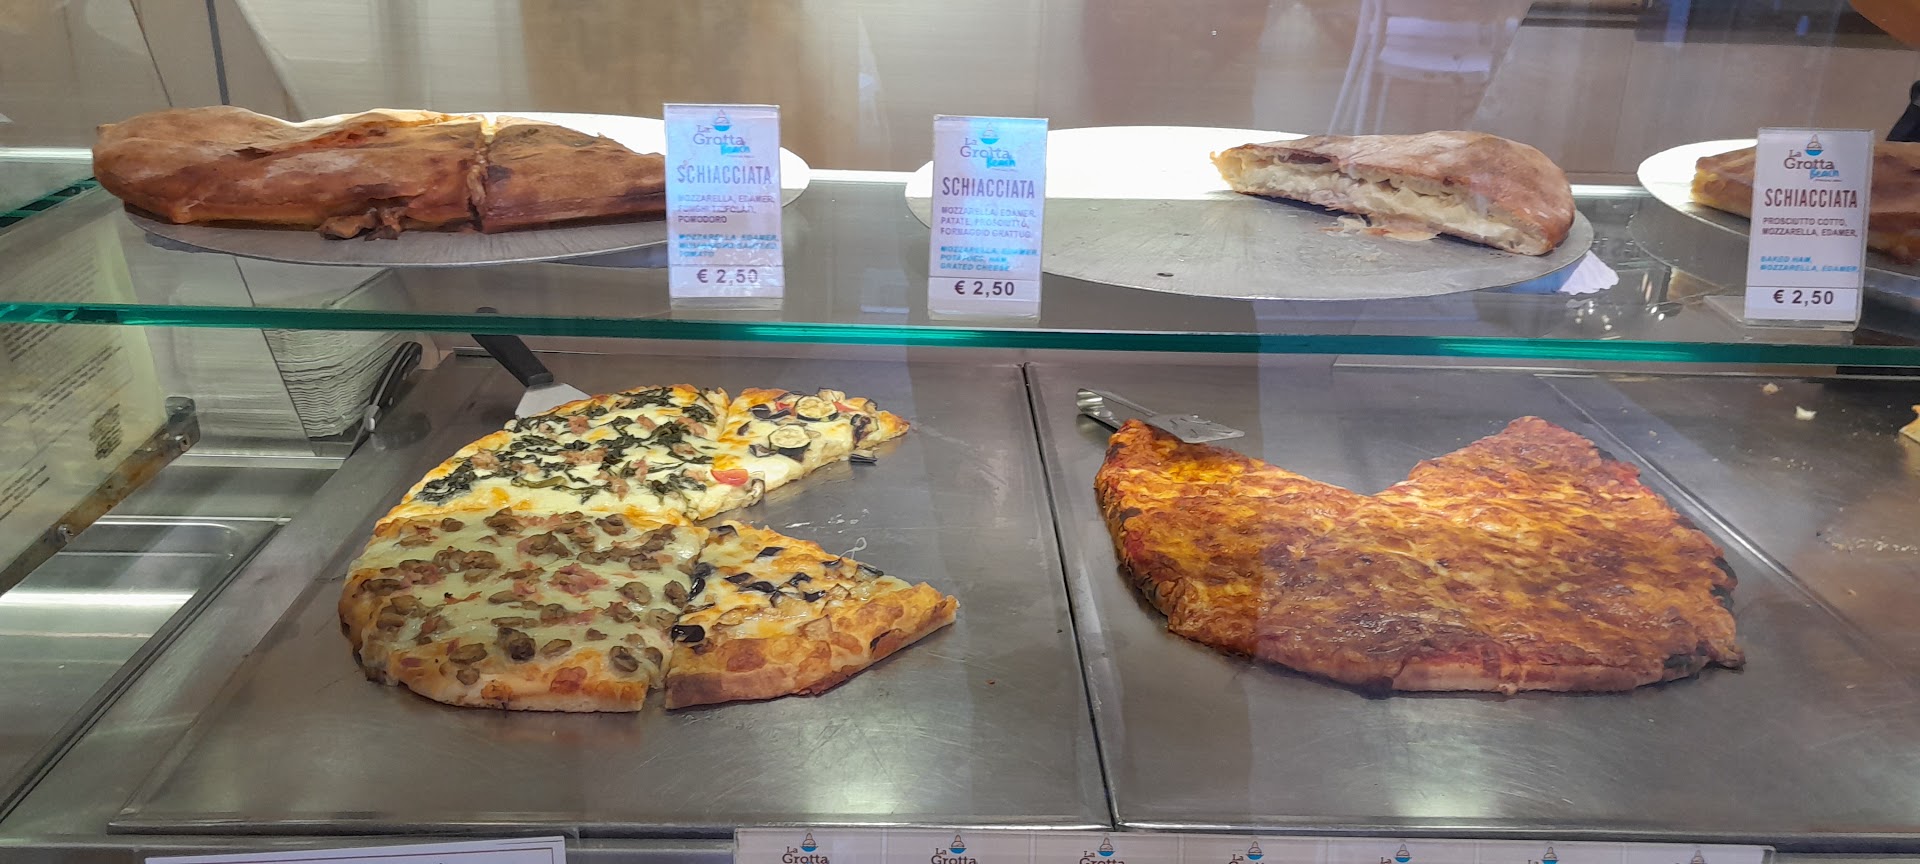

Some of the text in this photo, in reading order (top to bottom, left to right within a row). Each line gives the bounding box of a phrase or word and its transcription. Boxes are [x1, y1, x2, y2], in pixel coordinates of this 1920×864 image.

[693, 133, 746, 145] Grotta
[965, 138, 977, 146] La
[960, 145, 1012, 159] Grotta
[1789, 150, 1802, 158] La
[1784, 157, 1835, 170] Grotta
[677, 164, 772, 184] SCHIACCIATA
[942, 176, 1035, 198] SCHIACCIATA
[1764, 188, 1858, 208] SCHIACCIATA
[678, 215, 727, 223] POMODORO
[1763, 217, 1848, 227] PROSCIUTTO COTTO,
[1762, 228, 1858, 237] MOZZARELLA, EDAMER,
[940, 263, 974, 271] GRATED
[696, 269, 758, 286] € 2,50
[954, 280, 1015, 298] € 2,50
[1772, 289, 1834, 307] € 2,50
[782, 853, 829, 864] Grotta
[1083, 850, 1095, 858] La
[931, 856, 977, 864] Grotta
